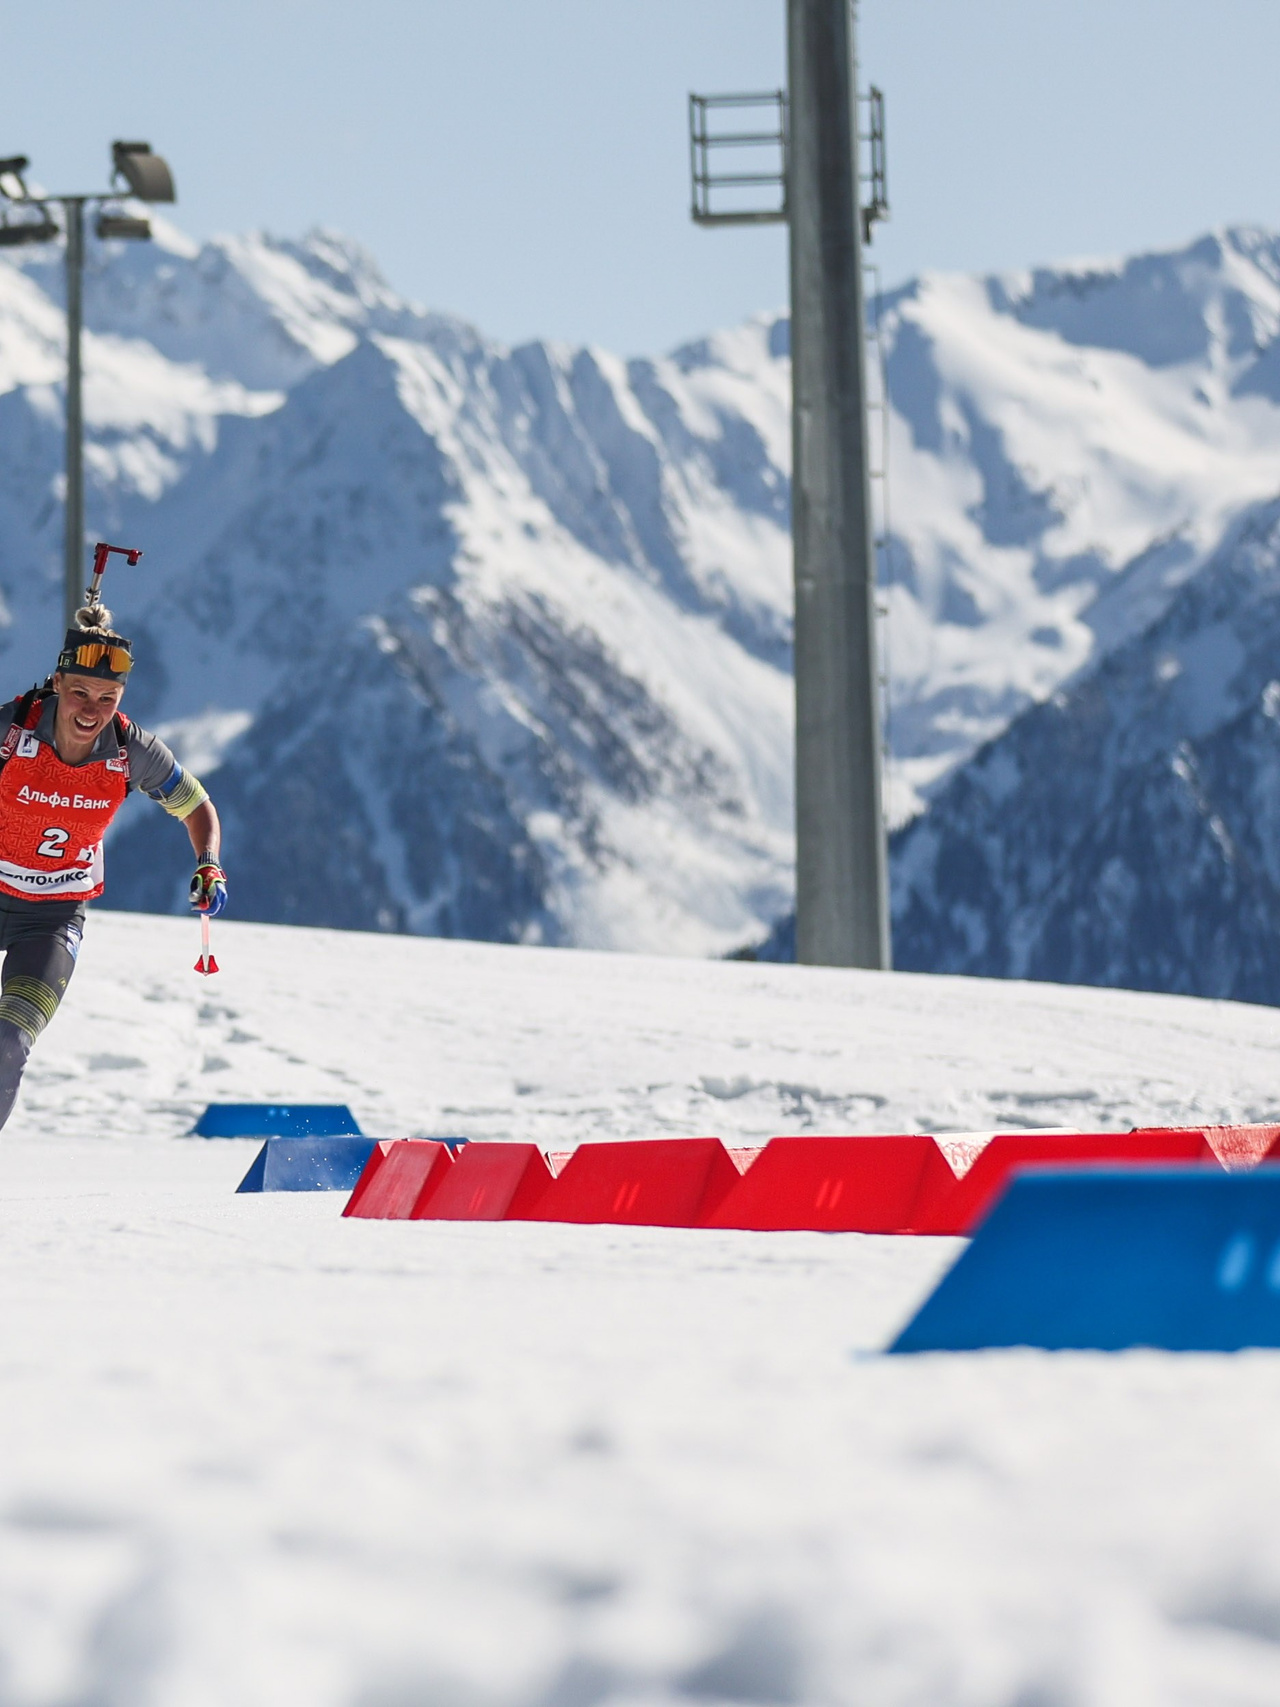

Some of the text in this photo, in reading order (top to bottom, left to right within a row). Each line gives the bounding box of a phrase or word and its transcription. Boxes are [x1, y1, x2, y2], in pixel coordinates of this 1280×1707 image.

[16, 785, 112, 810] Альфа Банк
[37, 827, 71, 858] 2
